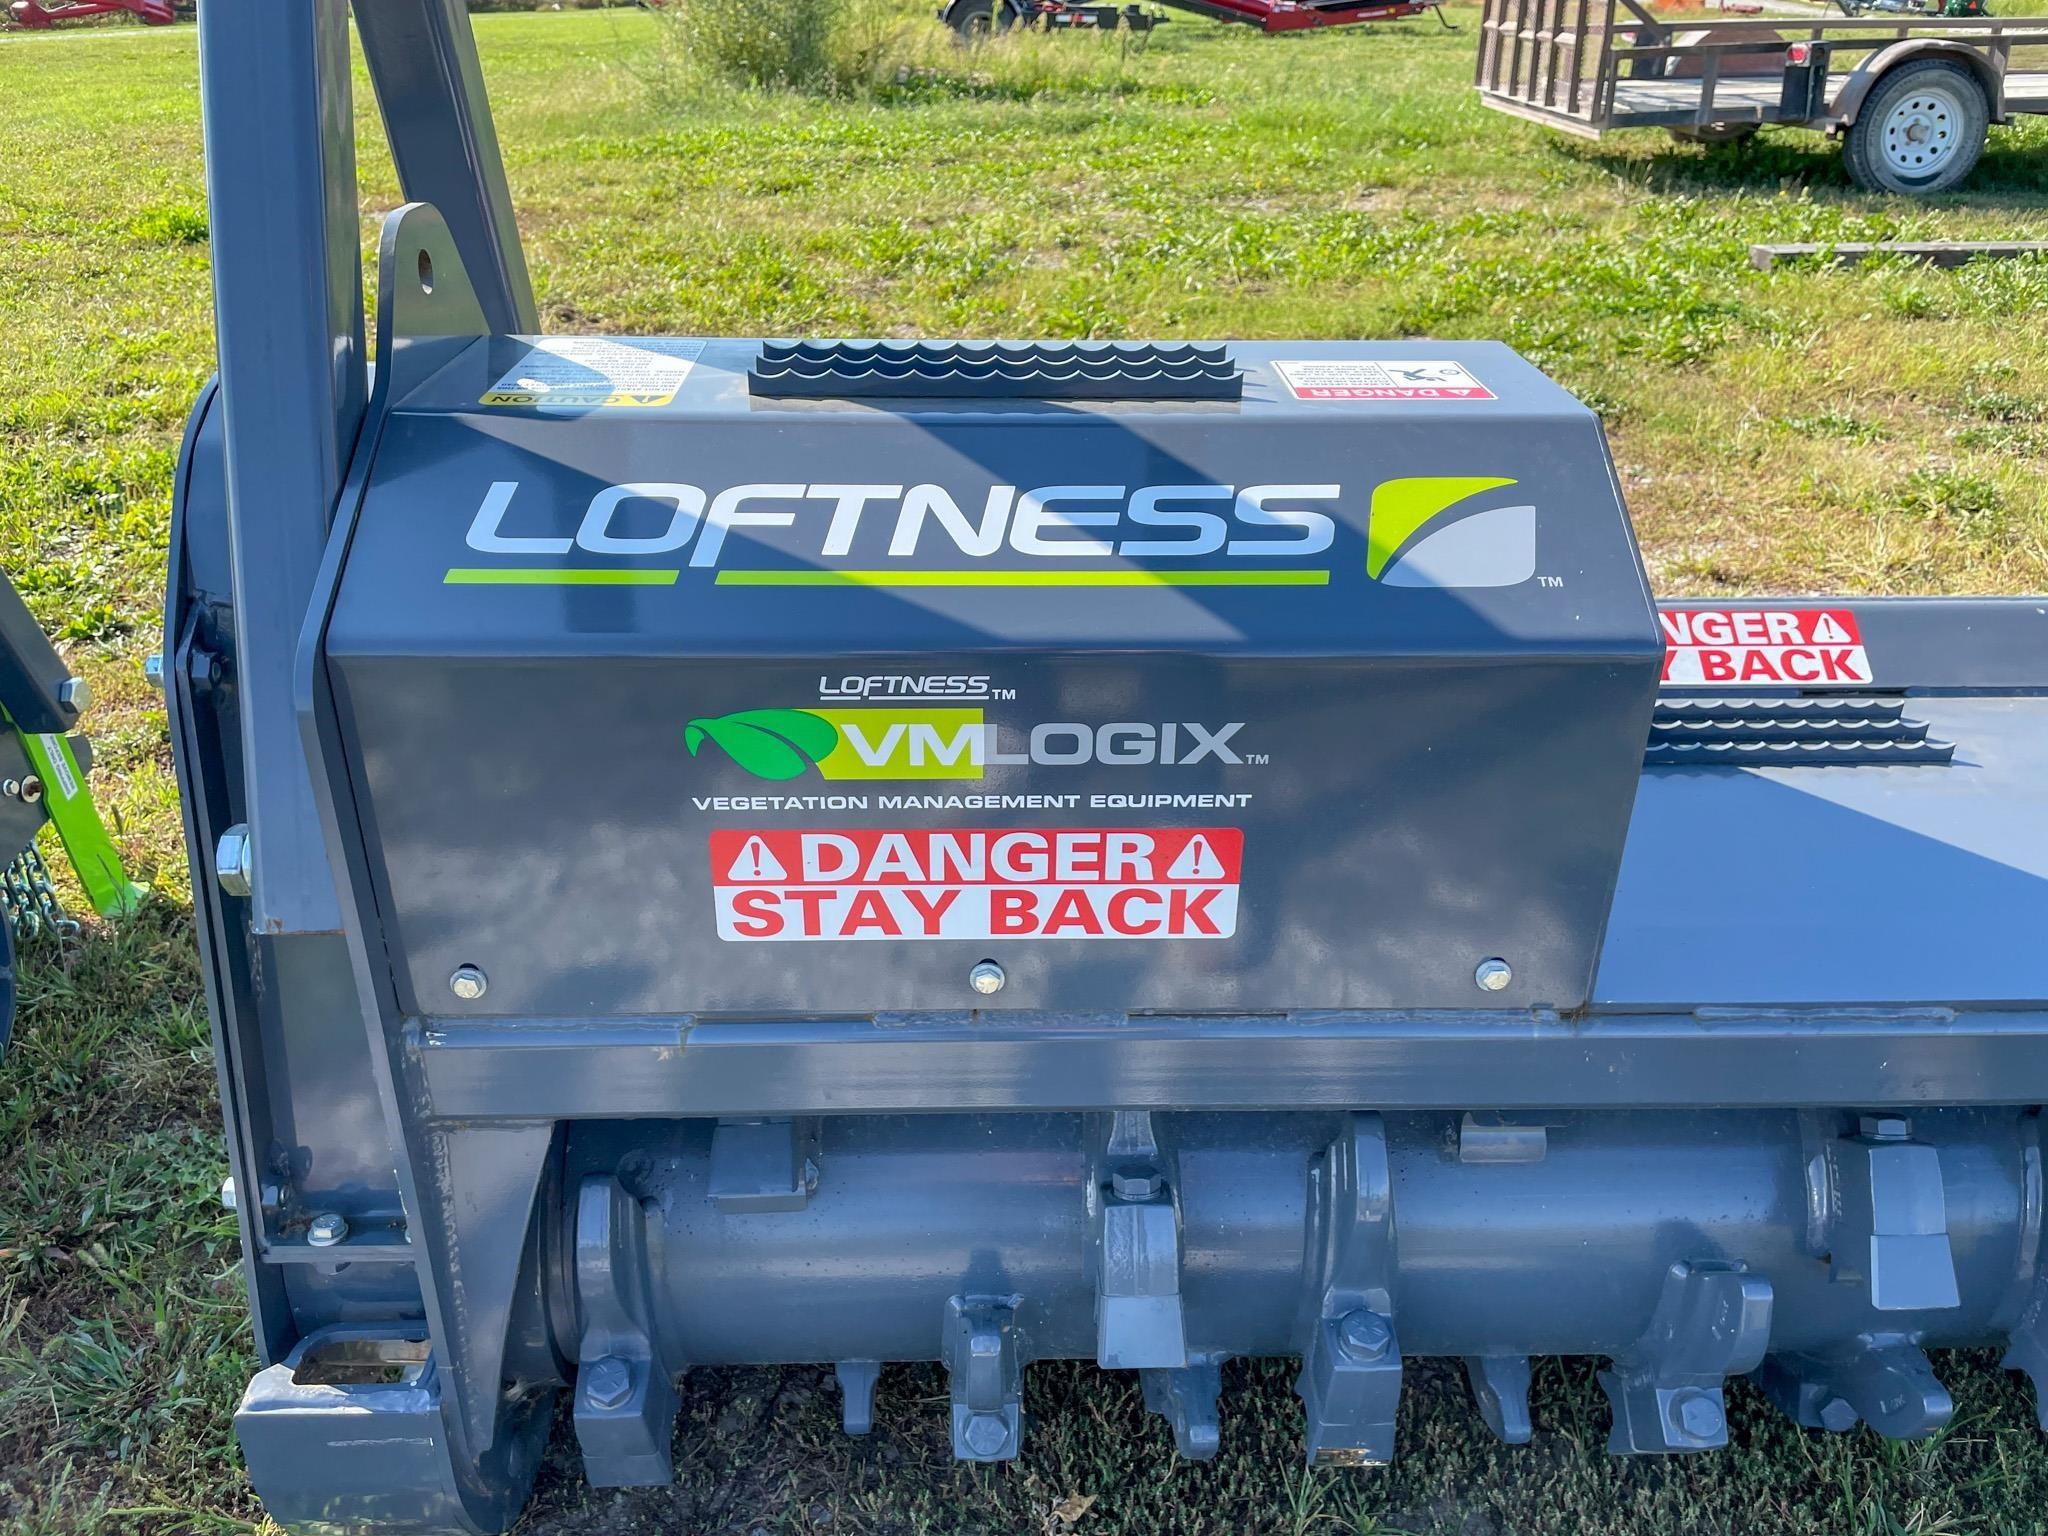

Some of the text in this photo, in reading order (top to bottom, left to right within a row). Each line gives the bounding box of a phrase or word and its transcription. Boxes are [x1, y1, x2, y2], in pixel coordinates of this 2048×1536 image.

[491, 395, 620, 404] CAUTION
[1311, 388, 1440, 397] DANGER
[465, 481, 1341, 568] LOFTNESS
[1658, 611, 1805, 646] NGER
[1698, 649, 1864, 681] BACK
[819, 675, 990, 697] LOFTNESS
[691, 794, 1253, 811] VEGETATION MANAGEMENT EQUIPMENT
[800, 832, 1157, 882] DANGER
[731, 888, 1225, 938] STAY BACK
